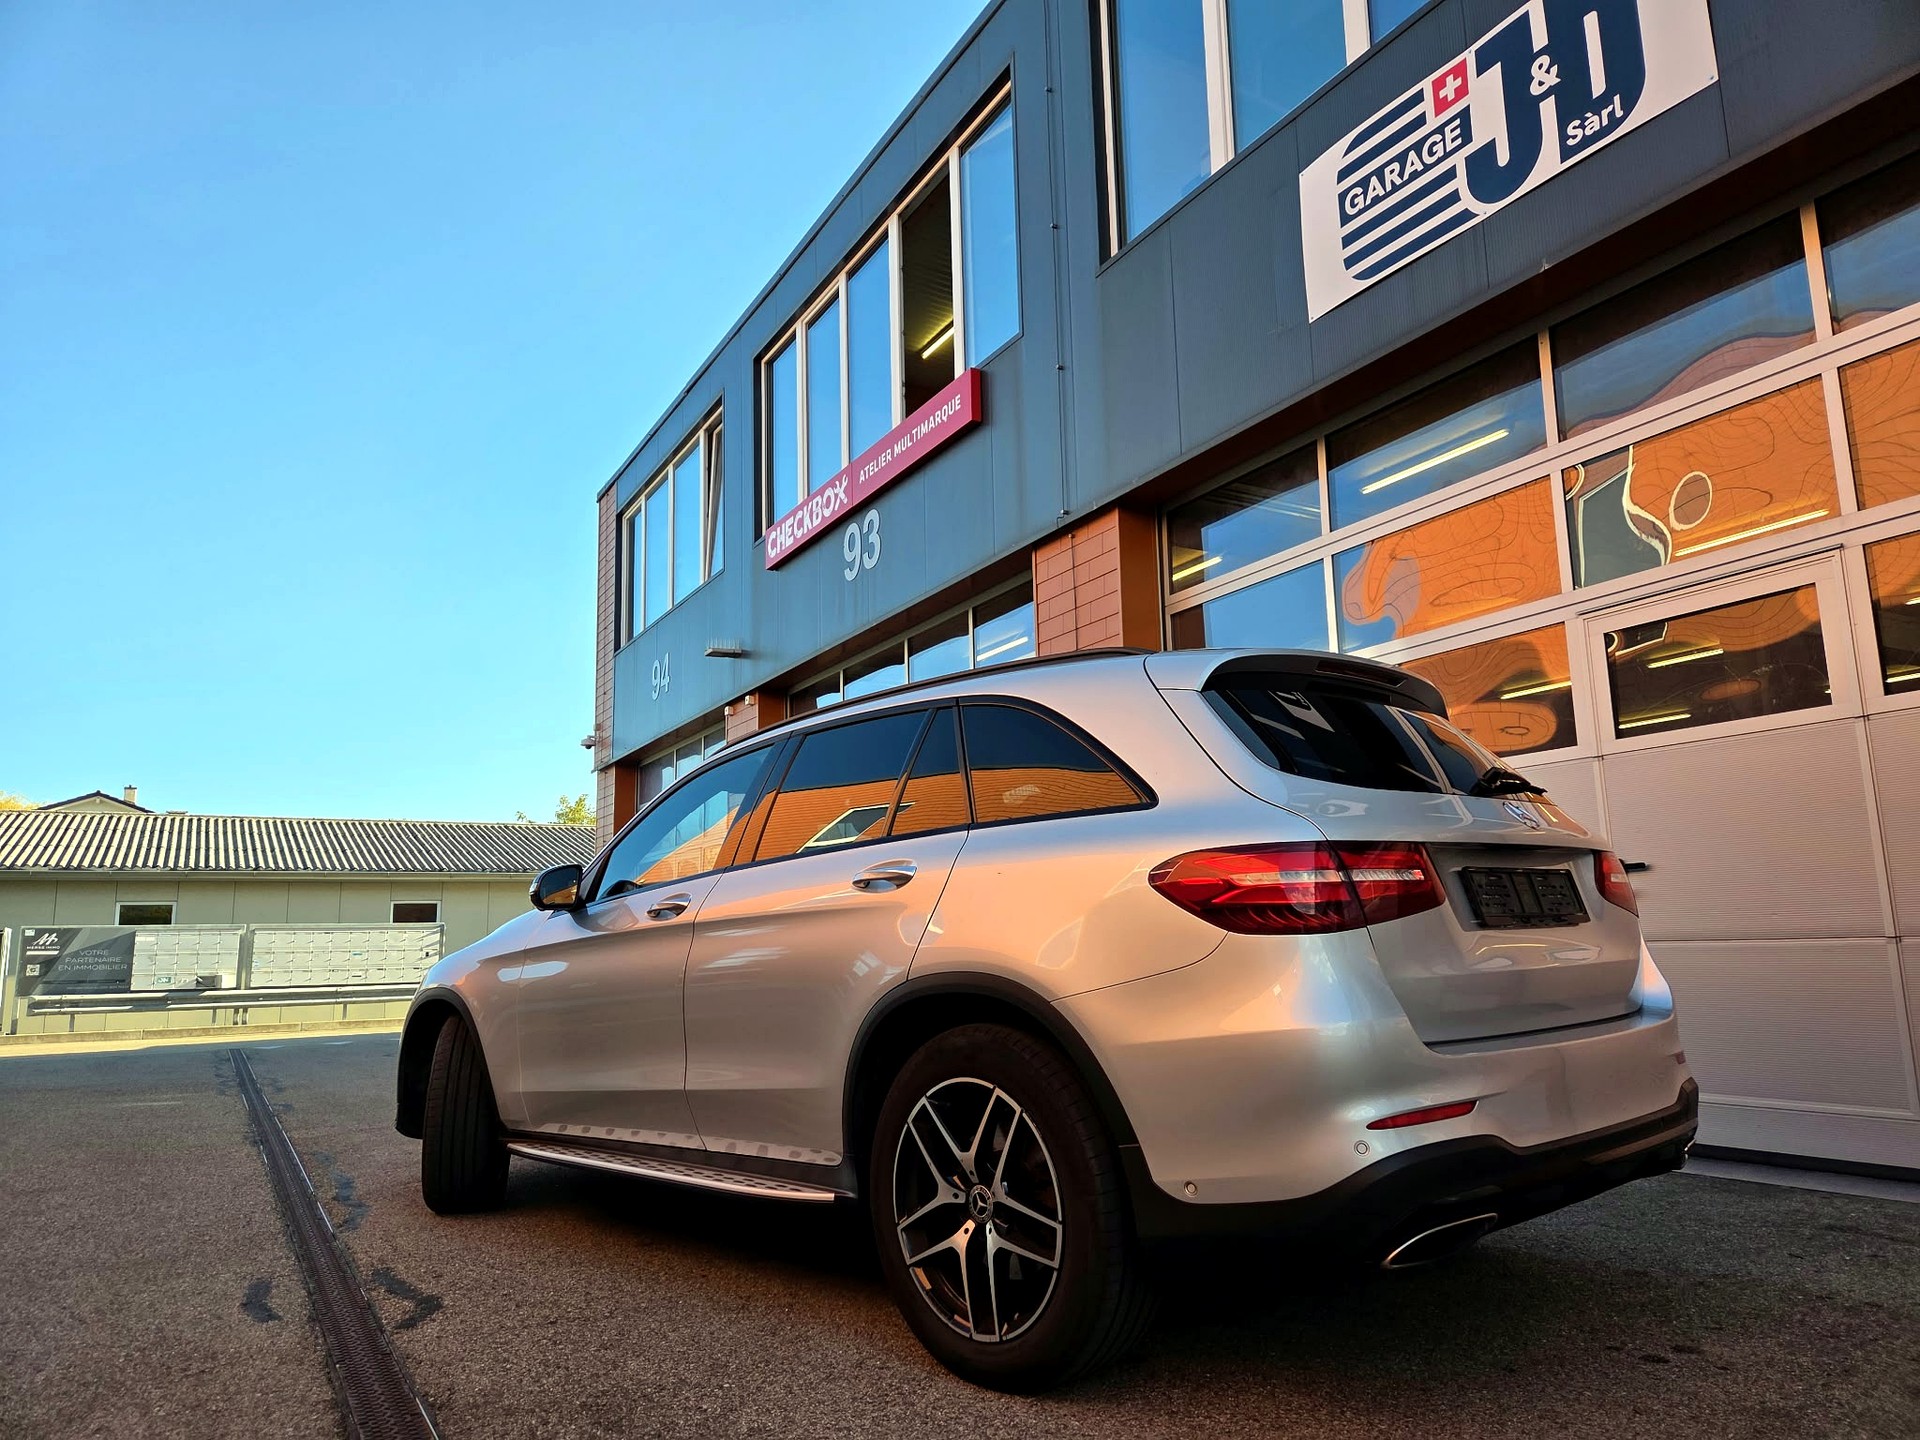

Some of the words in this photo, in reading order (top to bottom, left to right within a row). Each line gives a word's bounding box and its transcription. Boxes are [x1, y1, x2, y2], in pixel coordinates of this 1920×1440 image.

[1565, 93, 1624, 146] Sàrl
[1343, 118, 1464, 217] GARAGE
[766, 473, 849, 558] CHECKBOX
[858, 448, 893, 485] ATELIER
[893, 394, 962, 458] MULTIMARQUE
[843, 509, 881, 581] 93
[652, 652, 670, 701] 94
[73, 963, 128, 971] IMMOBILIER
